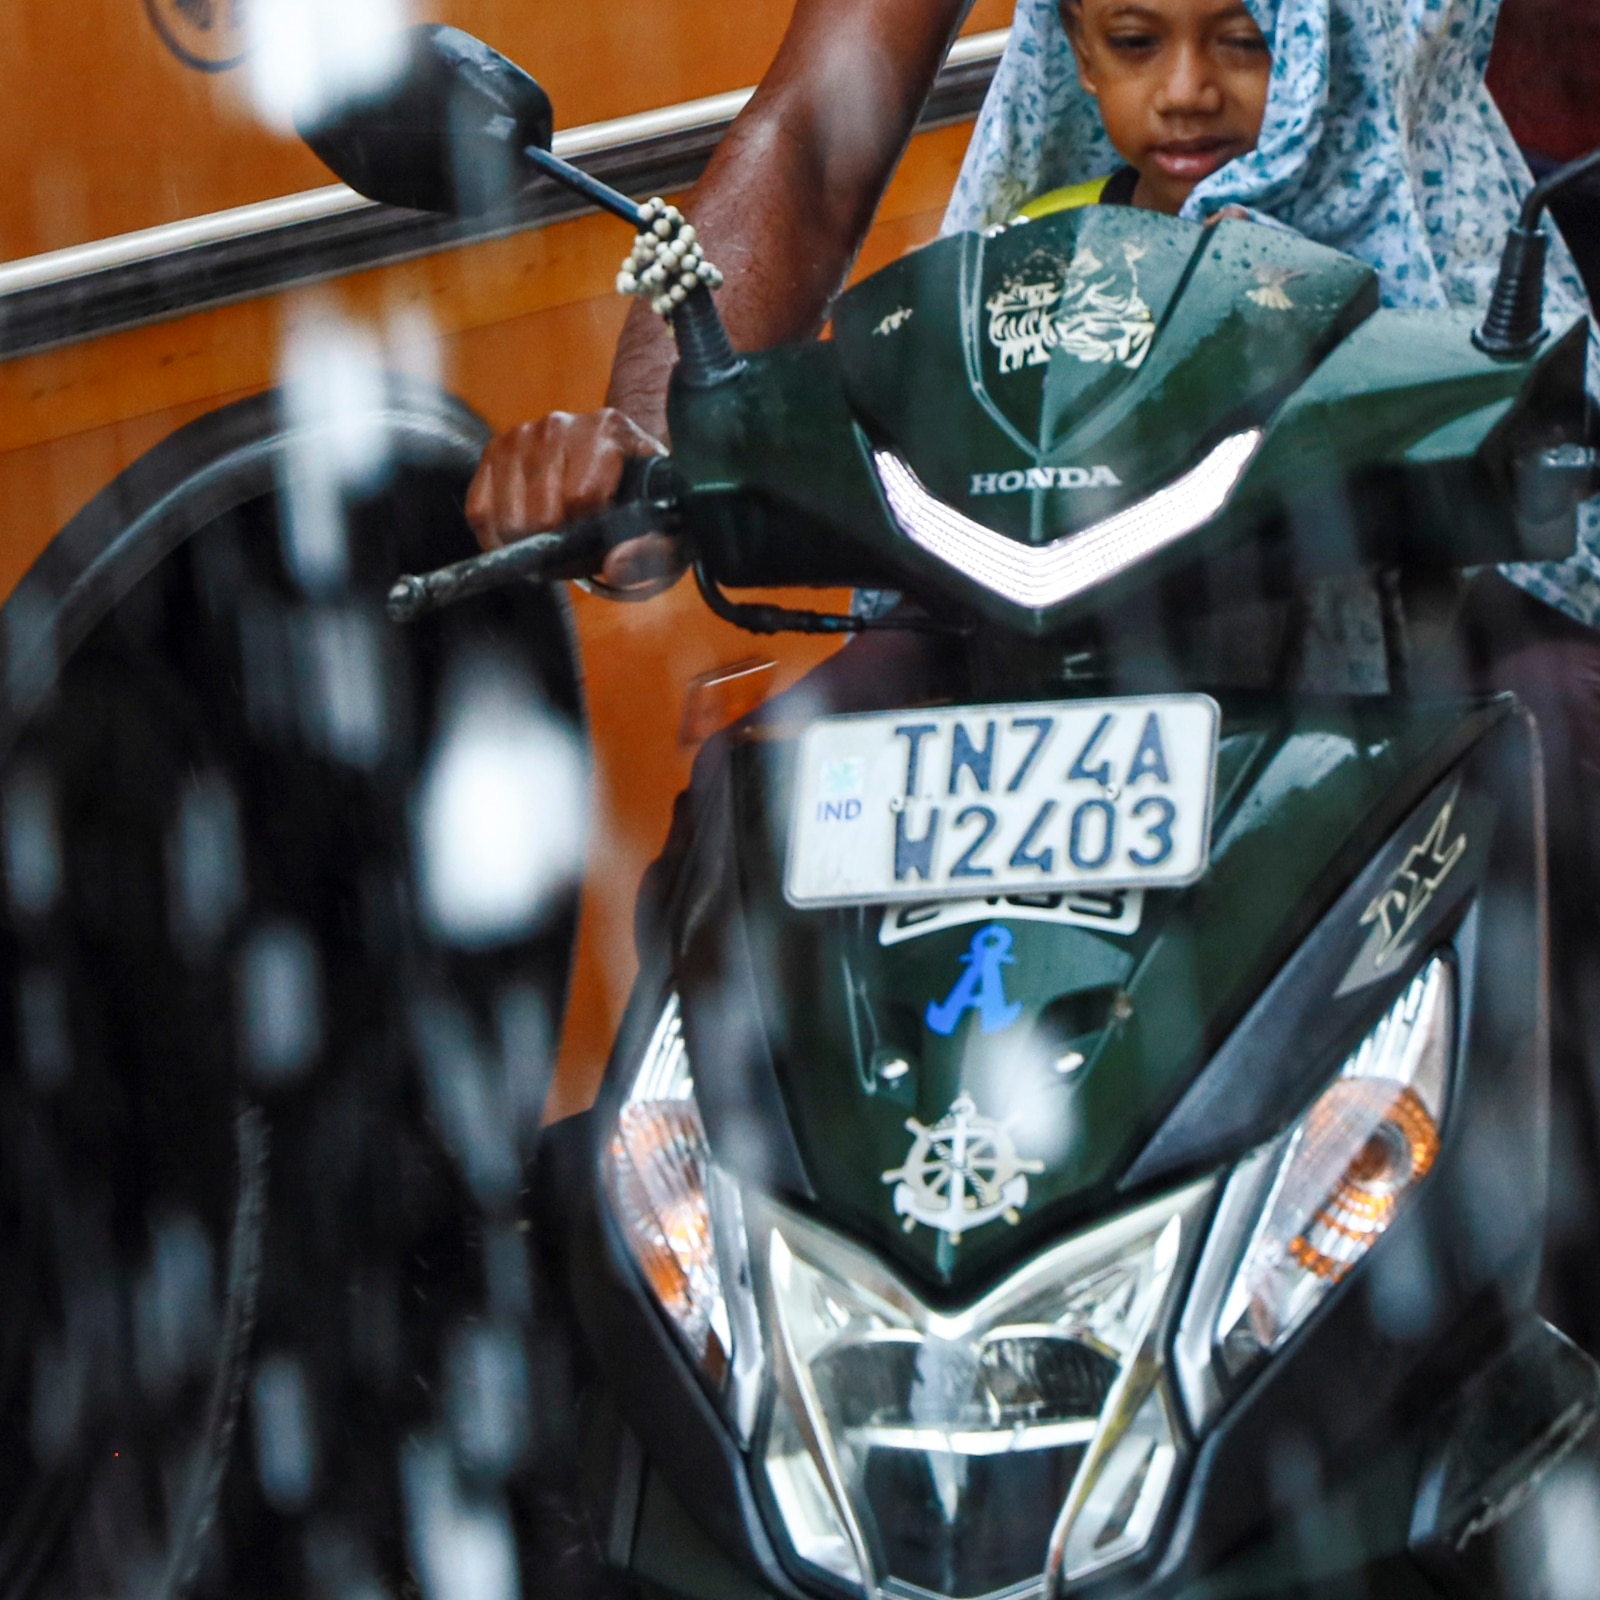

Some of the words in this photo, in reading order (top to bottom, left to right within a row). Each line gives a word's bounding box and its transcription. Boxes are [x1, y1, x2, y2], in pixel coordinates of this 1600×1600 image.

[969, 465, 1122, 496] HONDA
[816, 799, 863, 822] IND
[893, 794, 1177, 882] W2403
